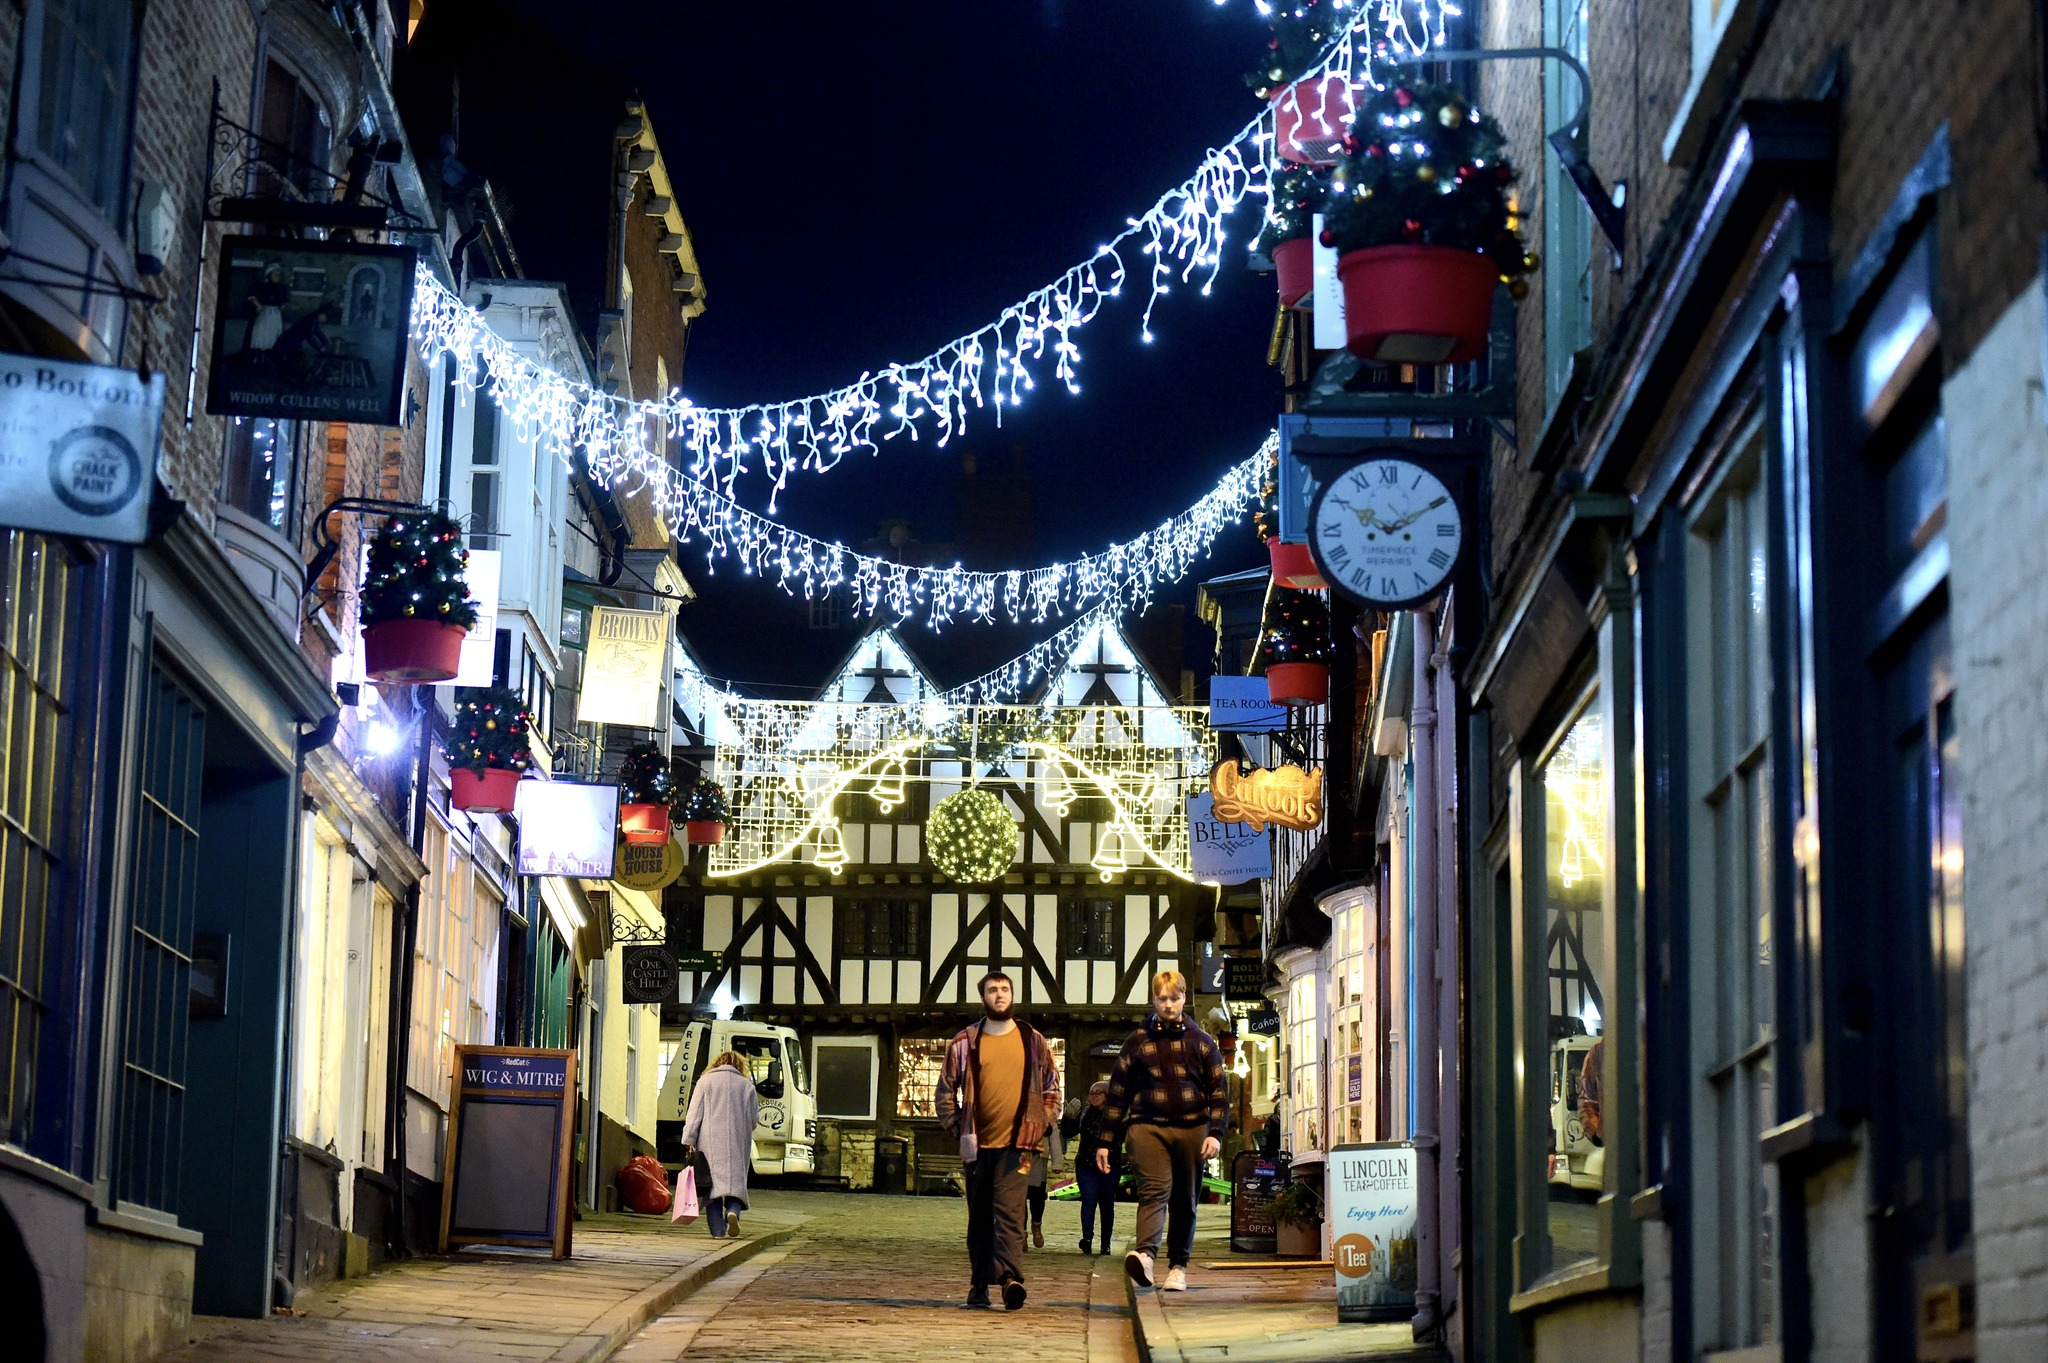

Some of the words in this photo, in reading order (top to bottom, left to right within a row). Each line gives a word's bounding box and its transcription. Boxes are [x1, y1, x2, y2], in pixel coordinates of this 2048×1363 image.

[229, 391, 276, 404] WIDOW
[346, 399, 381, 412] WELL
[72, 459, 119, 478] CHALK
[1379, 466, 1398, 484] XII
[72, 477, 115, 495] PAINT
[1350, 472, 1370, 493] XI
[1436, 524, 1455, 537] III
[598, 613, 661, 642] BROWNS
[1214, 699, 1237, 708] TEA
[624, 846, 663, 860] MOUSE
[624, 860, 663, 875] HOUSE
[1218, 868, 1243, 876] COFFEE
[640, 959, 661, 970] ONE
[1231, 964, 1261, 973] ROLY
[633, 968, 669, 979] CASTLE
[639, 978, 663, 988] HILL
[1229, 984, 1260, 993] PANT
[1251, 1016, 1280, 1031] Cahoo
[466, 1069, 498, 1083] WIG
[500, 1071, 513, 1084] &
[517, 1071, 565, 1087] MITRE
[677, 1030, 693, 1118] RECOVERY
[1343, 1159, 1408, 1179] LINCOLN
[1346, 1206, 1377, 1221] Enjoy
[1378, 1205, 1409, 1217] Here!
[1248, 1224, 1275, 1233] OPEN
[1344, 1245, 1367, 1267] Tea
